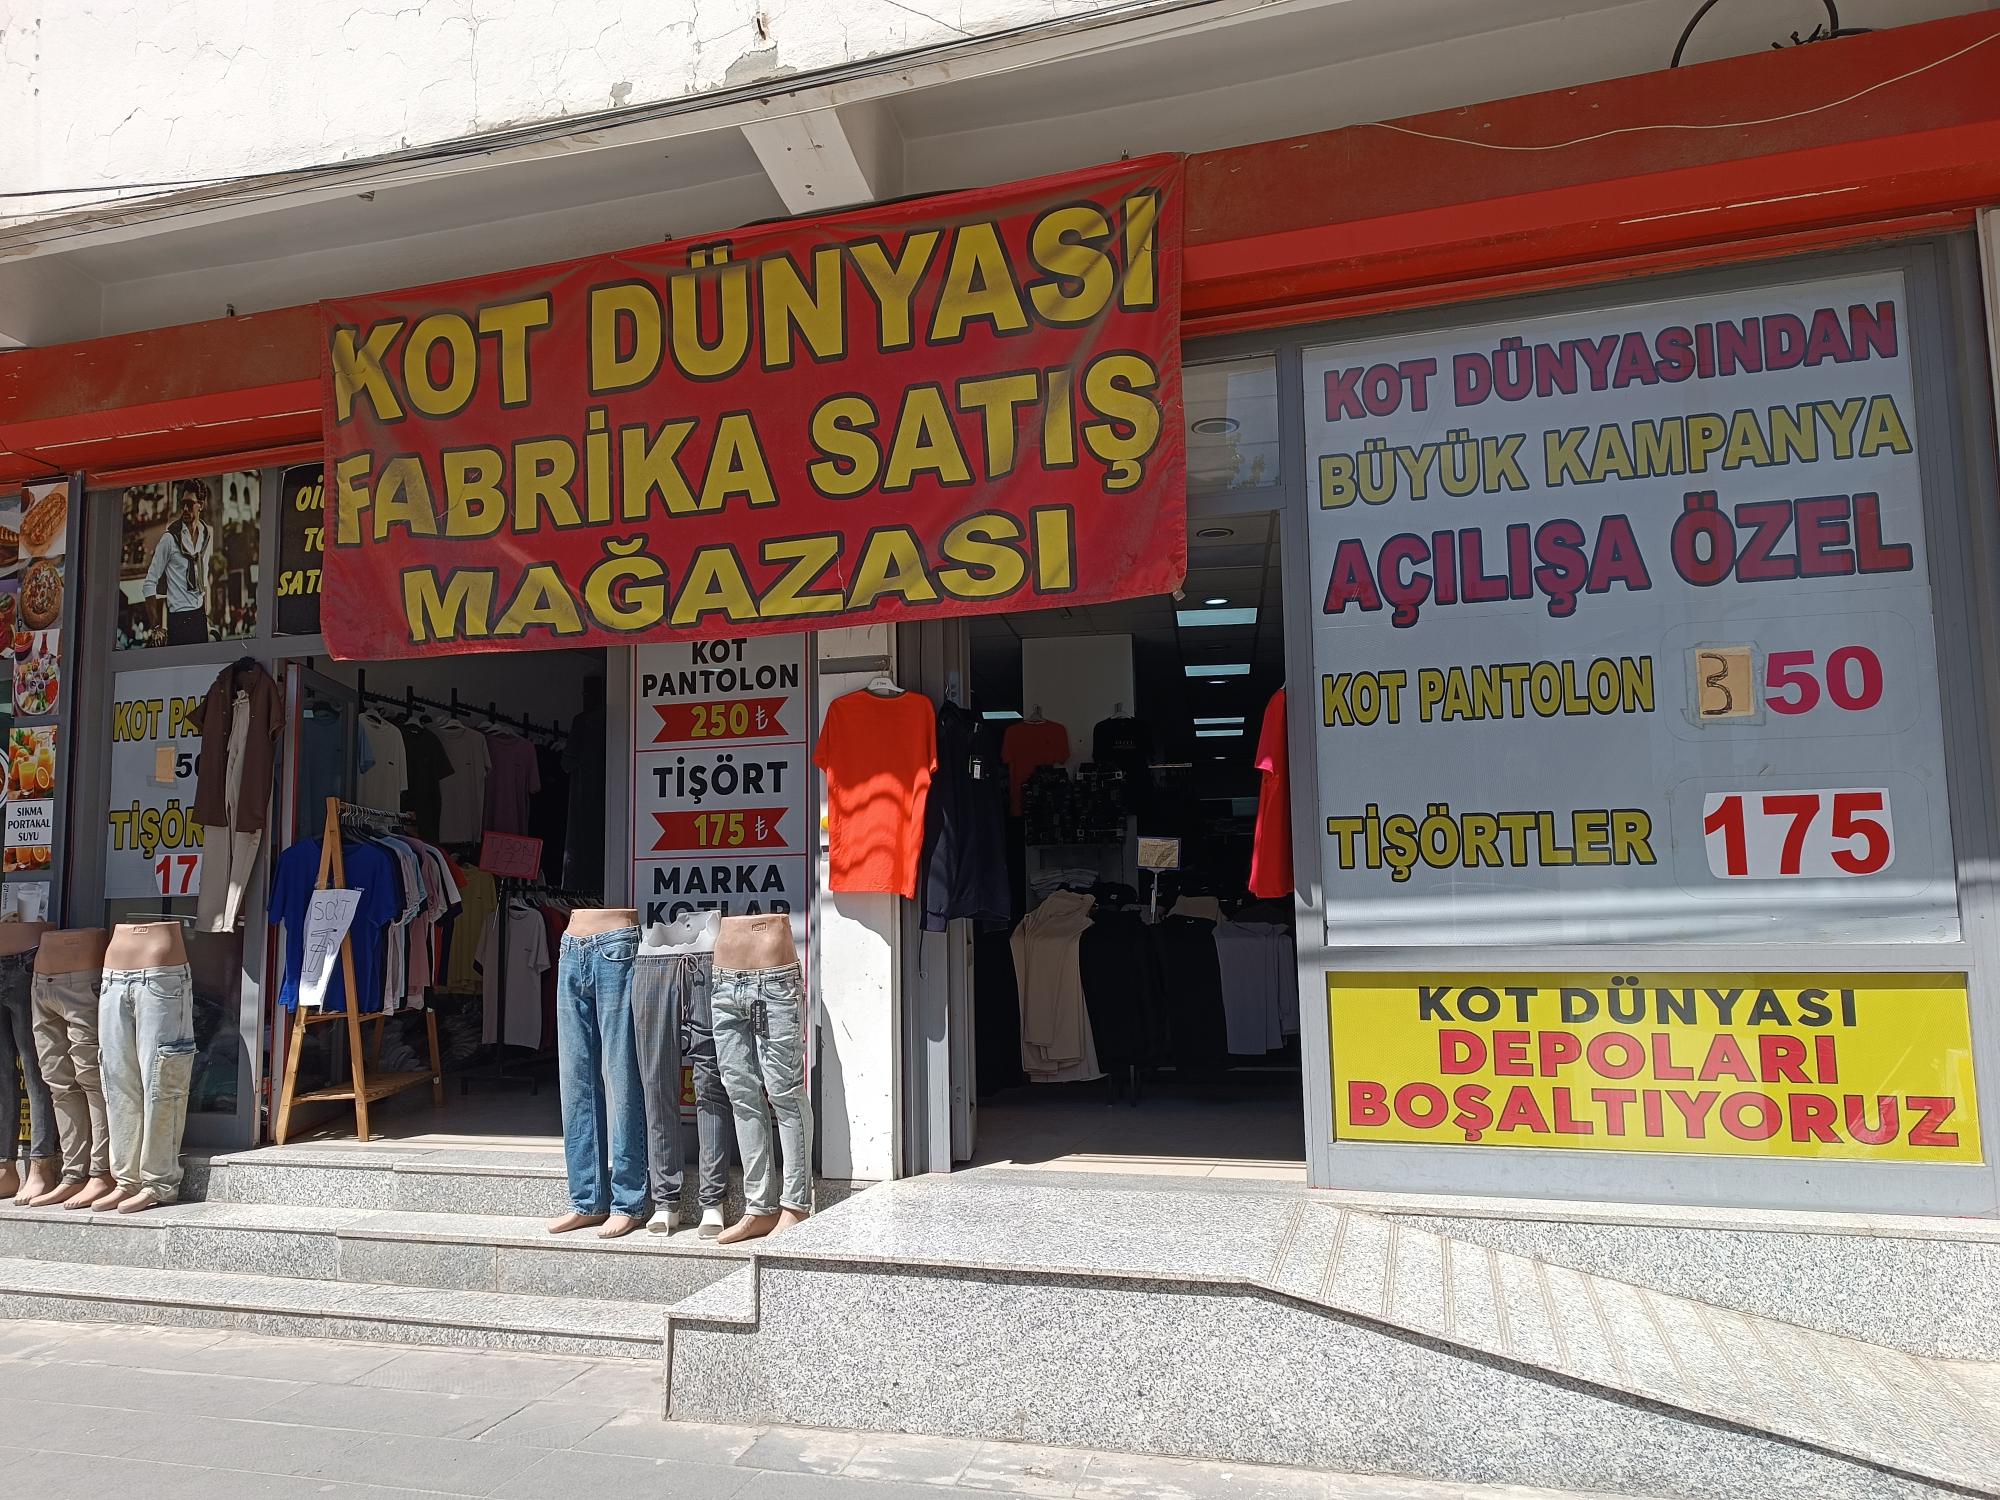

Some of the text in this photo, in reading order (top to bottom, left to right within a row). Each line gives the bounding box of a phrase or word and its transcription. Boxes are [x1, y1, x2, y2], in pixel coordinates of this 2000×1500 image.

[329, 187, 1161, 425] KOT DÜNYASI
[1324, 301, 1898, 422] KOT DÜNYASINDAN
[333, 350, 1163, 549] FABRİKA SATIŞ
[1319, 394, 1913, 510] BÜYÜK KAMPANYA
[400, 504, 1077, 646] MAĞAZASI
[1323, 490, 1913, 628] AÇILIŞA ÖZEL
[692, 638, 747, 665] KOT
[642, 663, 799, 698] PANTOLON
[1322, 669, 1407, 727] KOT
[1419, 656, 1655, 723] PANTOLON
[112, 696, 206, 742] KOT PA
[690, 703, 749, 738] 250
[175, 753, 201, 778] 5
[653, 753, 788, 805] TİŞÖRT
[7, 818, 51, 830] PORTAKAL
[17, 806, 42, 817] SIKMA
[18, 831, 40, 842] SUYU
[693, 813, 745, 846] 175
[1327, 791, 1890, 882] TİŞÖRTLER 175
[156, 854, 200, 894] 17
[653, 864, 786, 895] MARKA
[1419, 975, 1857, 1028] KOT DÜNYASI
[1439, 1029, 1838, 1085] DEPOLARI
[1347, 1080, 1959, 1149] BOŞALTIYORUZ
